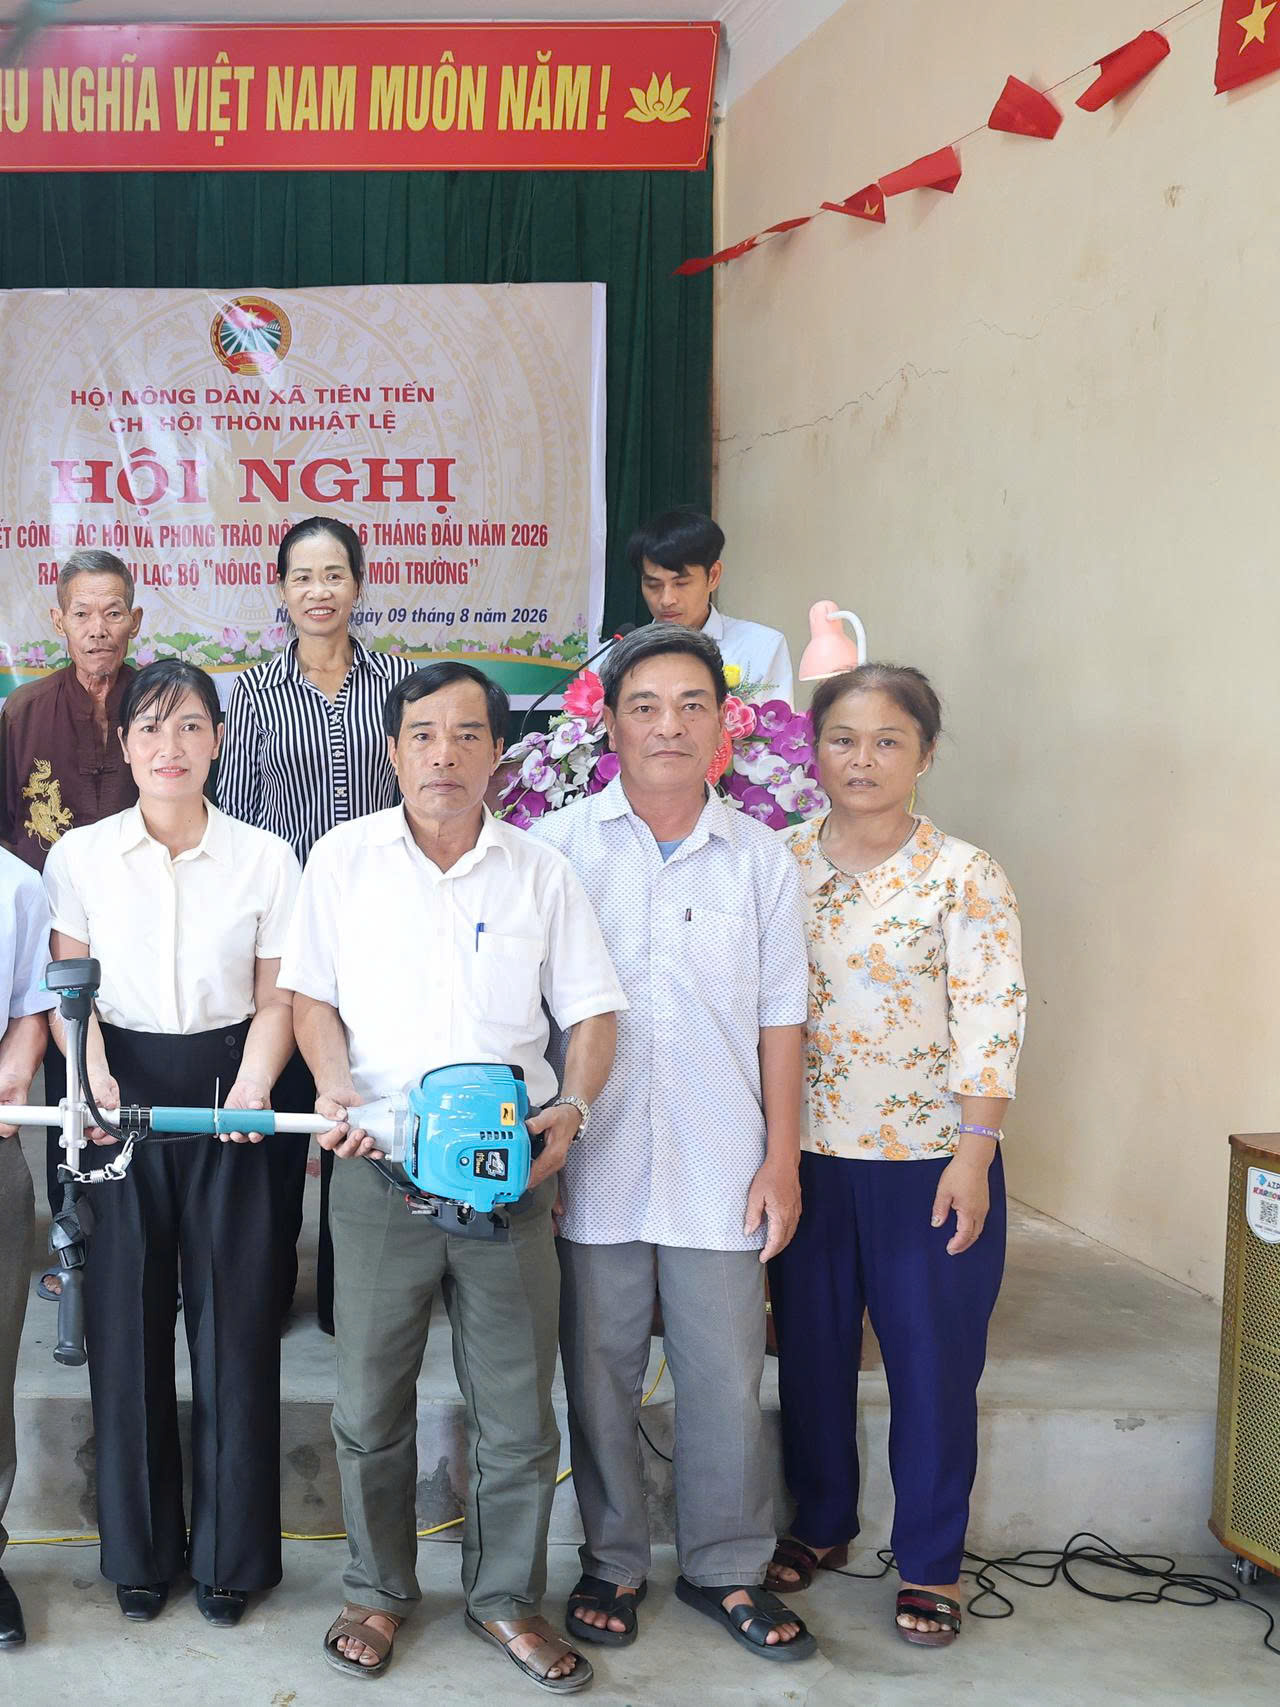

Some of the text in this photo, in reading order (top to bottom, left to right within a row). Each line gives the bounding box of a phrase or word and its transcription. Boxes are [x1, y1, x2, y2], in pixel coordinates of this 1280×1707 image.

[42, 53, 160, 132] NGHĨA
[173, 51, 254, 146] VIỆT
[266, 64, 358, 131] NAM
[369, 50, 487, 131] MUÔN
[70, 380, 435, 411] HỘI NÔNG DÂN XÃ TIÊN TIẾN
[160, 411, 203, 436] HỘI
[211, 411, 280, 432] THÔN
[289, 412, 360, 435] NHẬT
[369, 410, 397, 434] LỆ
[50, 446, 457, 517] HỘI NGHỊ
[102, 519, 129, 551] HỘI
[134, 519, 154, 548] VÀ
[159, 524, 216, 548] PHONG
[221, 519, 263, 547] TRÀO
[358, 523, 368, 546] 6
[373, 519, 426, 547] THÁNG
[431, 515, 463, 547] ĐẦU
[468, 518, 507, 547] NĂM
[511, 523, 549, 547] 2026
[143, 562, 173, 591] LẠC
[177, 561, 200, 591] BỘ
[369, 557, 400, 585] MÔI
[387, 608, 407, 623] 09
[412, 608, 456, 626] tháng
[460, 608, 469, 623] 8
[474, 608, 507, 623] năm
[511, 608, 549, 623] 2026
